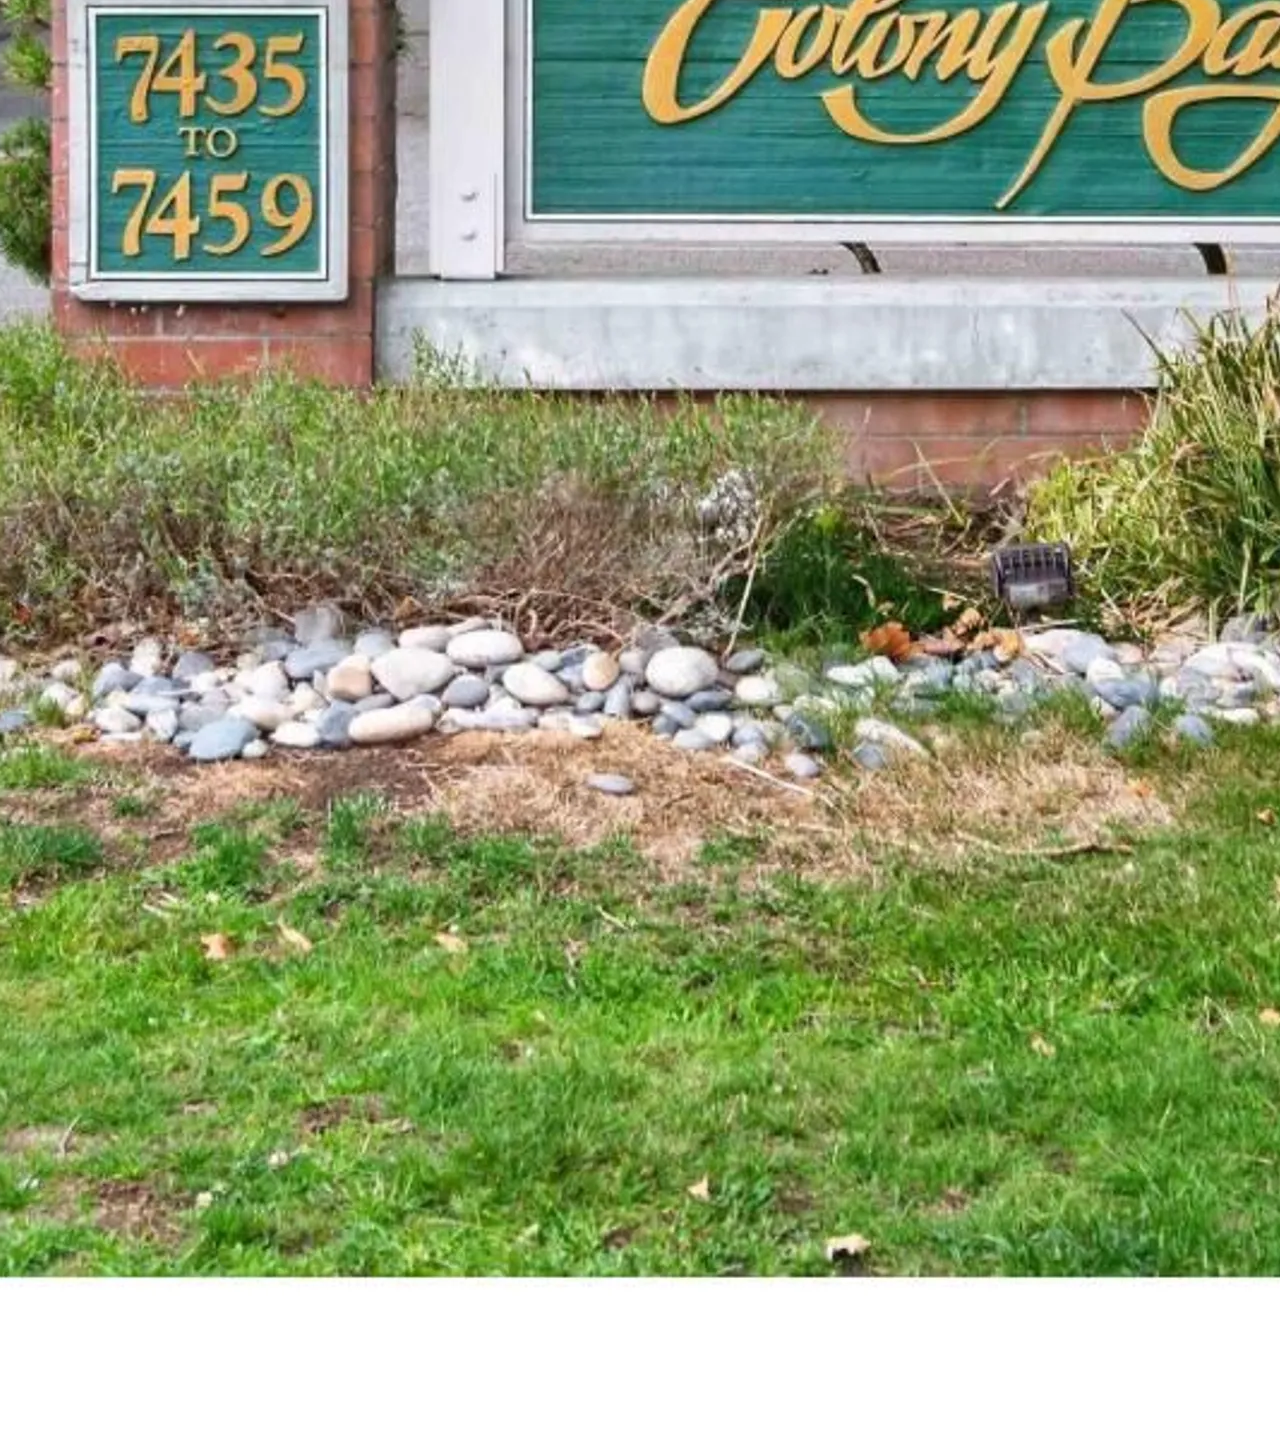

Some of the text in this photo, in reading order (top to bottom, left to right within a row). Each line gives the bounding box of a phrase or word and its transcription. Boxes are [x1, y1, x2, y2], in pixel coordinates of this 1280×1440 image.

[115, 29, 307, 123] 7435
[179, 127, 238, 158] TO
[112, 169, 314, 261] 7459
